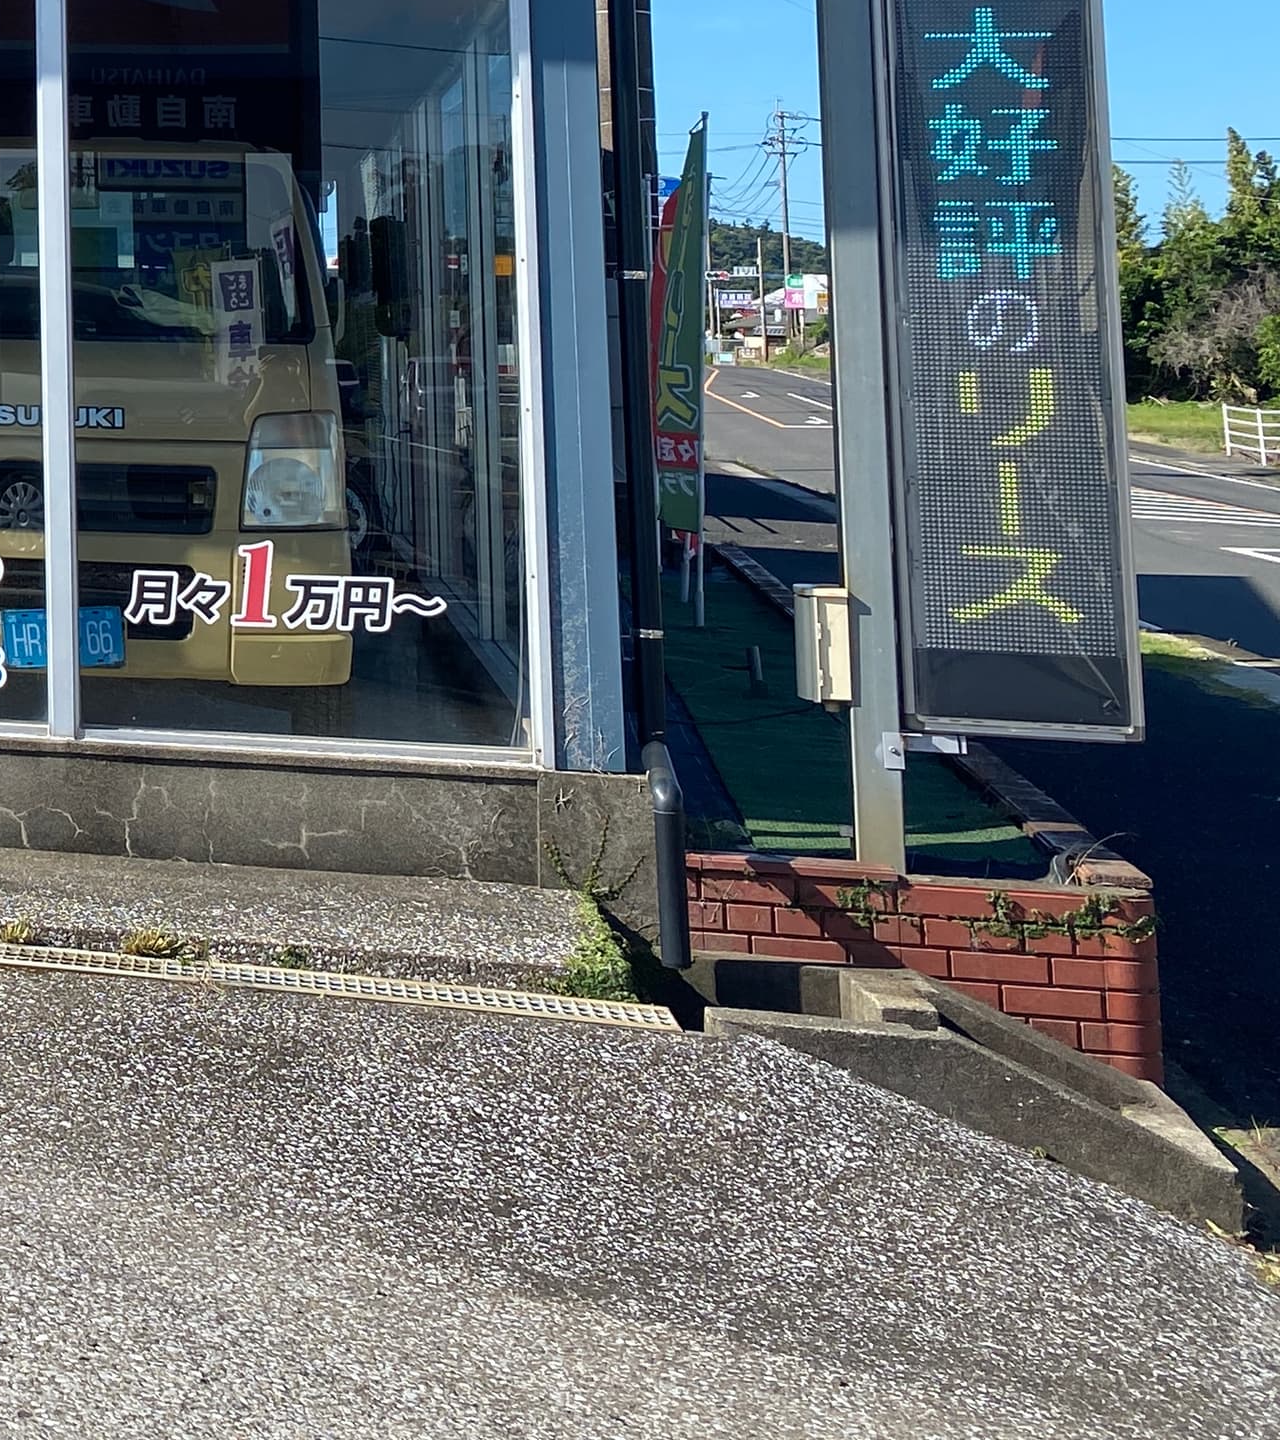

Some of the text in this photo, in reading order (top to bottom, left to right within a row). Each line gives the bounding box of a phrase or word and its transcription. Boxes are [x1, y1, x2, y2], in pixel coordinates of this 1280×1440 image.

[923, 5, 1085, 625] 大好評のリース
